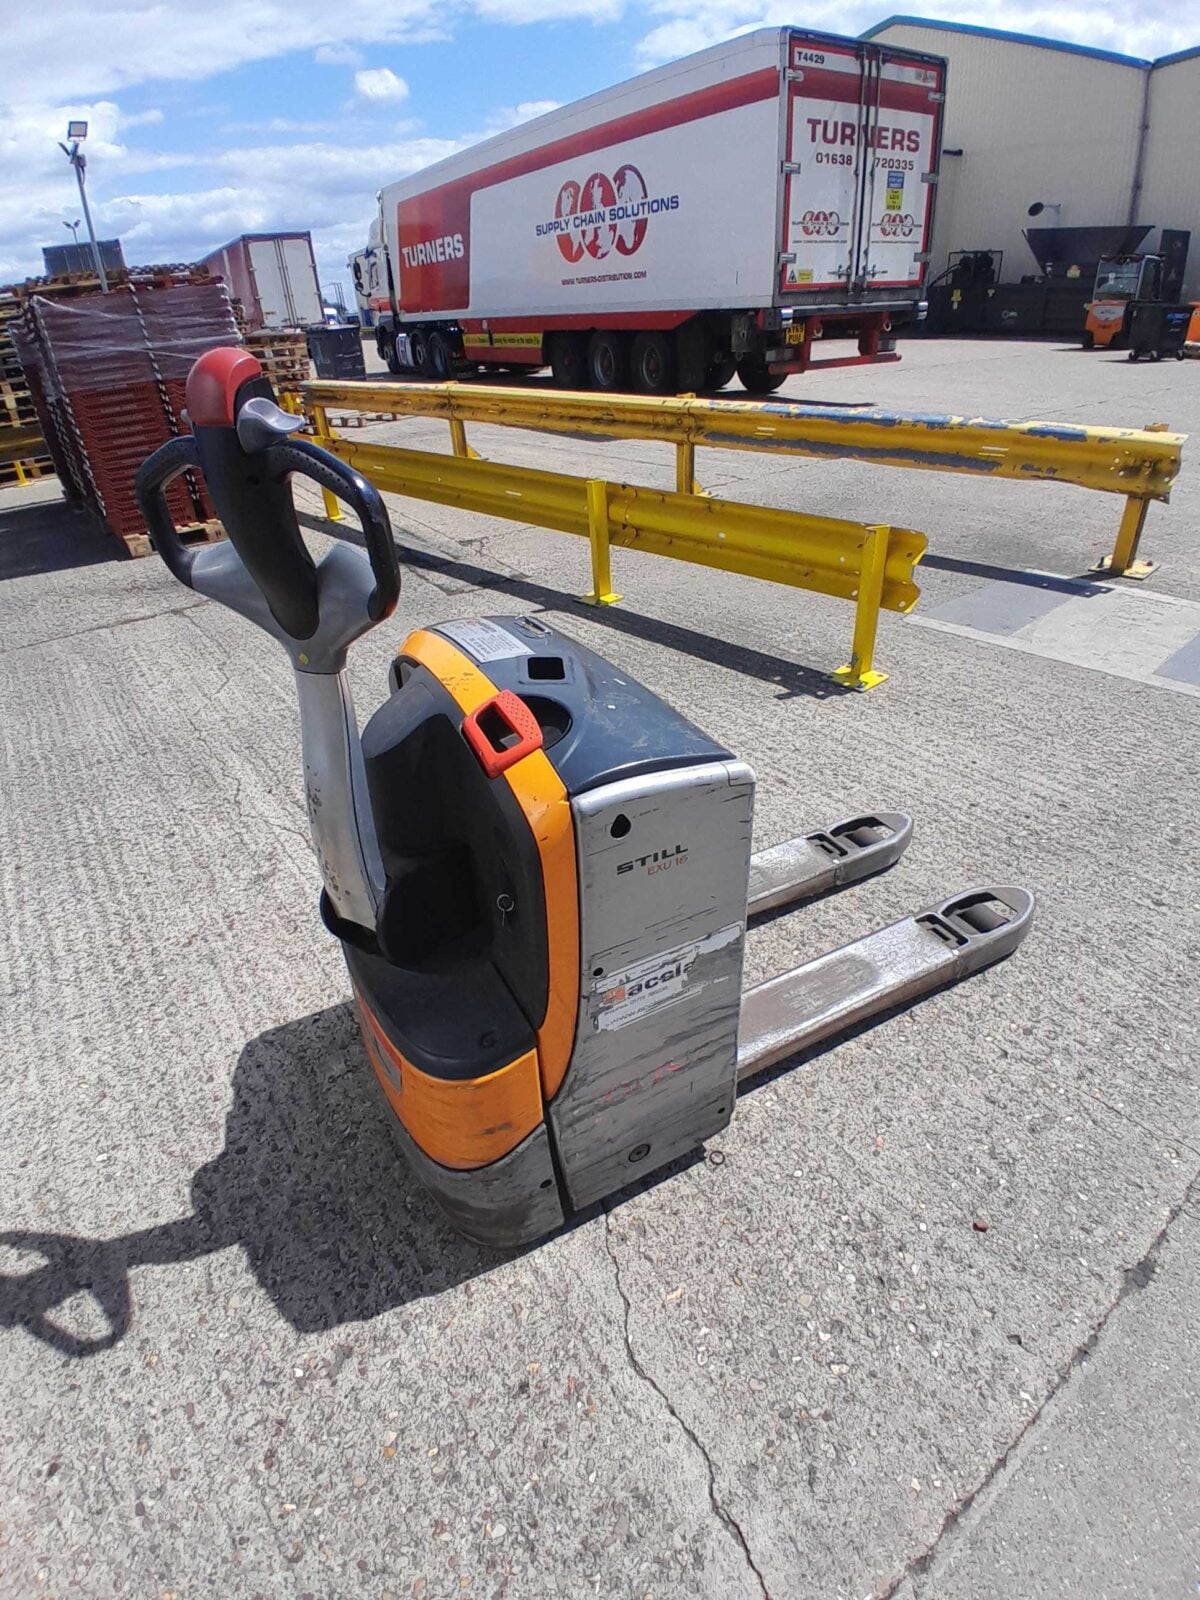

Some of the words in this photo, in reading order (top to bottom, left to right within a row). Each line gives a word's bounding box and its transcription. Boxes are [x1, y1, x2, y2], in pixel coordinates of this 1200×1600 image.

[796, 50, 825, 65] T4429
[815, 152, 853, 166] 01638
[875, 157, 914, 171] 720335
[535, 218, 571, 237] SUPPLY
[573, 210, 606, 229] CHAIN
[609, 194, 680, 221] SOLUTIONS
[401, 233, 465, 269] TURNERS
[616, 844, 689, 876] STILL
[647, 860, 672, 876] EXU
